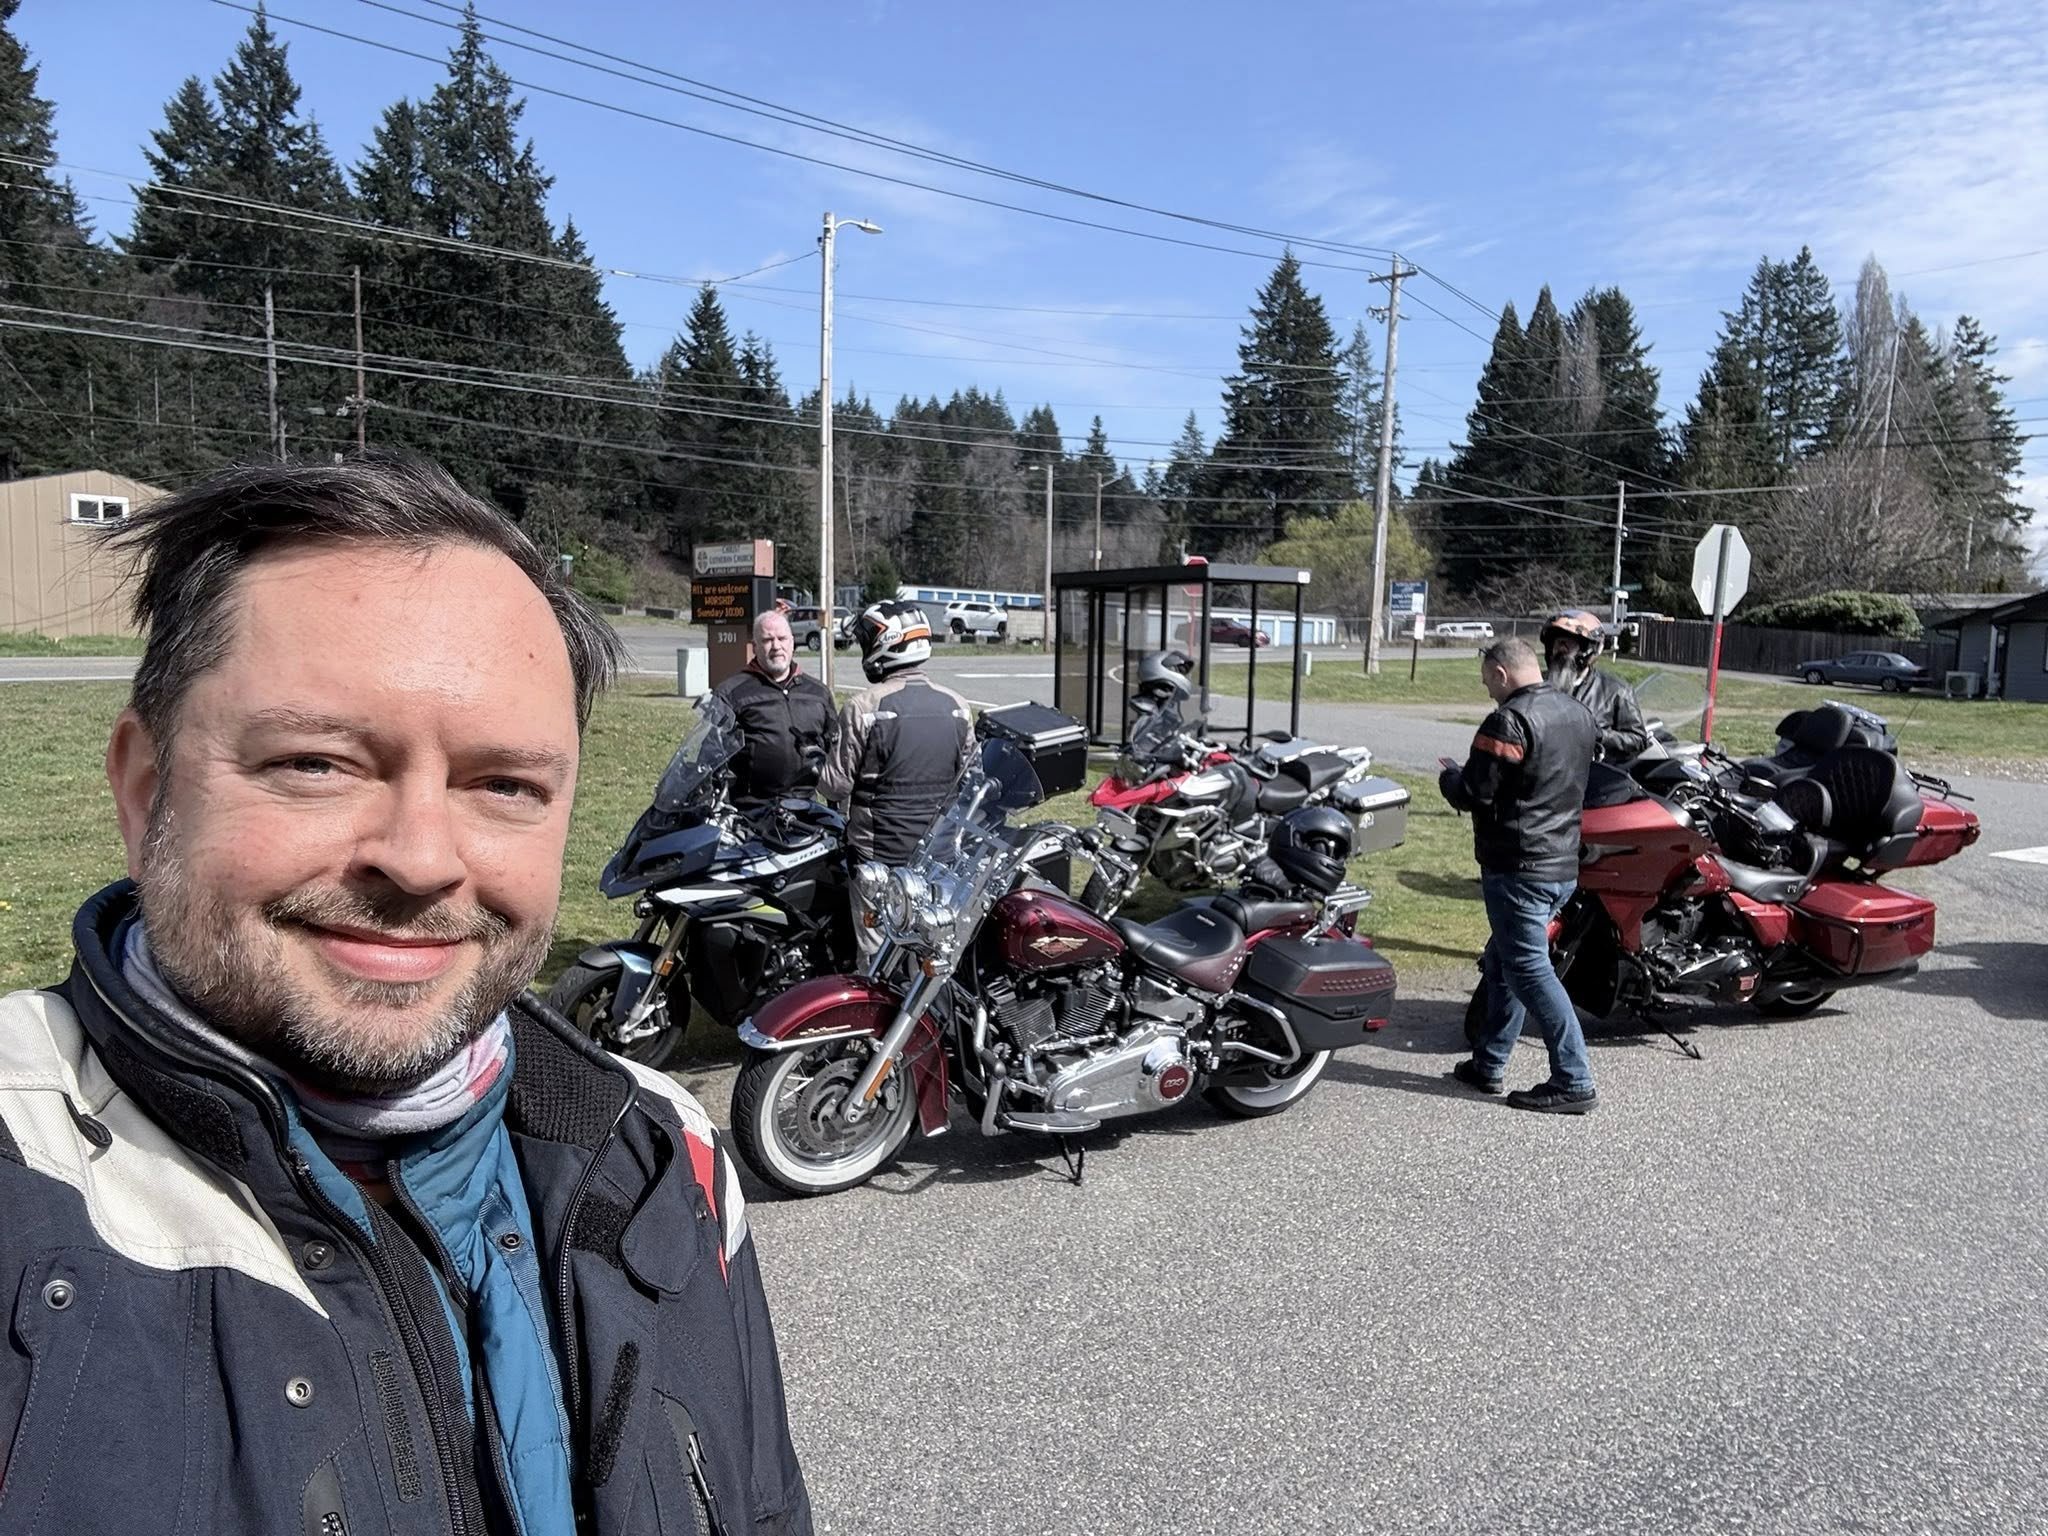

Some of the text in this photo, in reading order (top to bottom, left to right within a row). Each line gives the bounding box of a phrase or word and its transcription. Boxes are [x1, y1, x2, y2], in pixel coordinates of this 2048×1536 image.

[709, 554, 752, 565] LUTHERAN CHURCH
[692, 584, 749, 594] All are welcome
[704, 595, 735, 605] WORSHIP
[697, 607, 724, 618] Sunday
[718, 632, 737, 643] 3701
[881, 631, 902, 642] Arai
